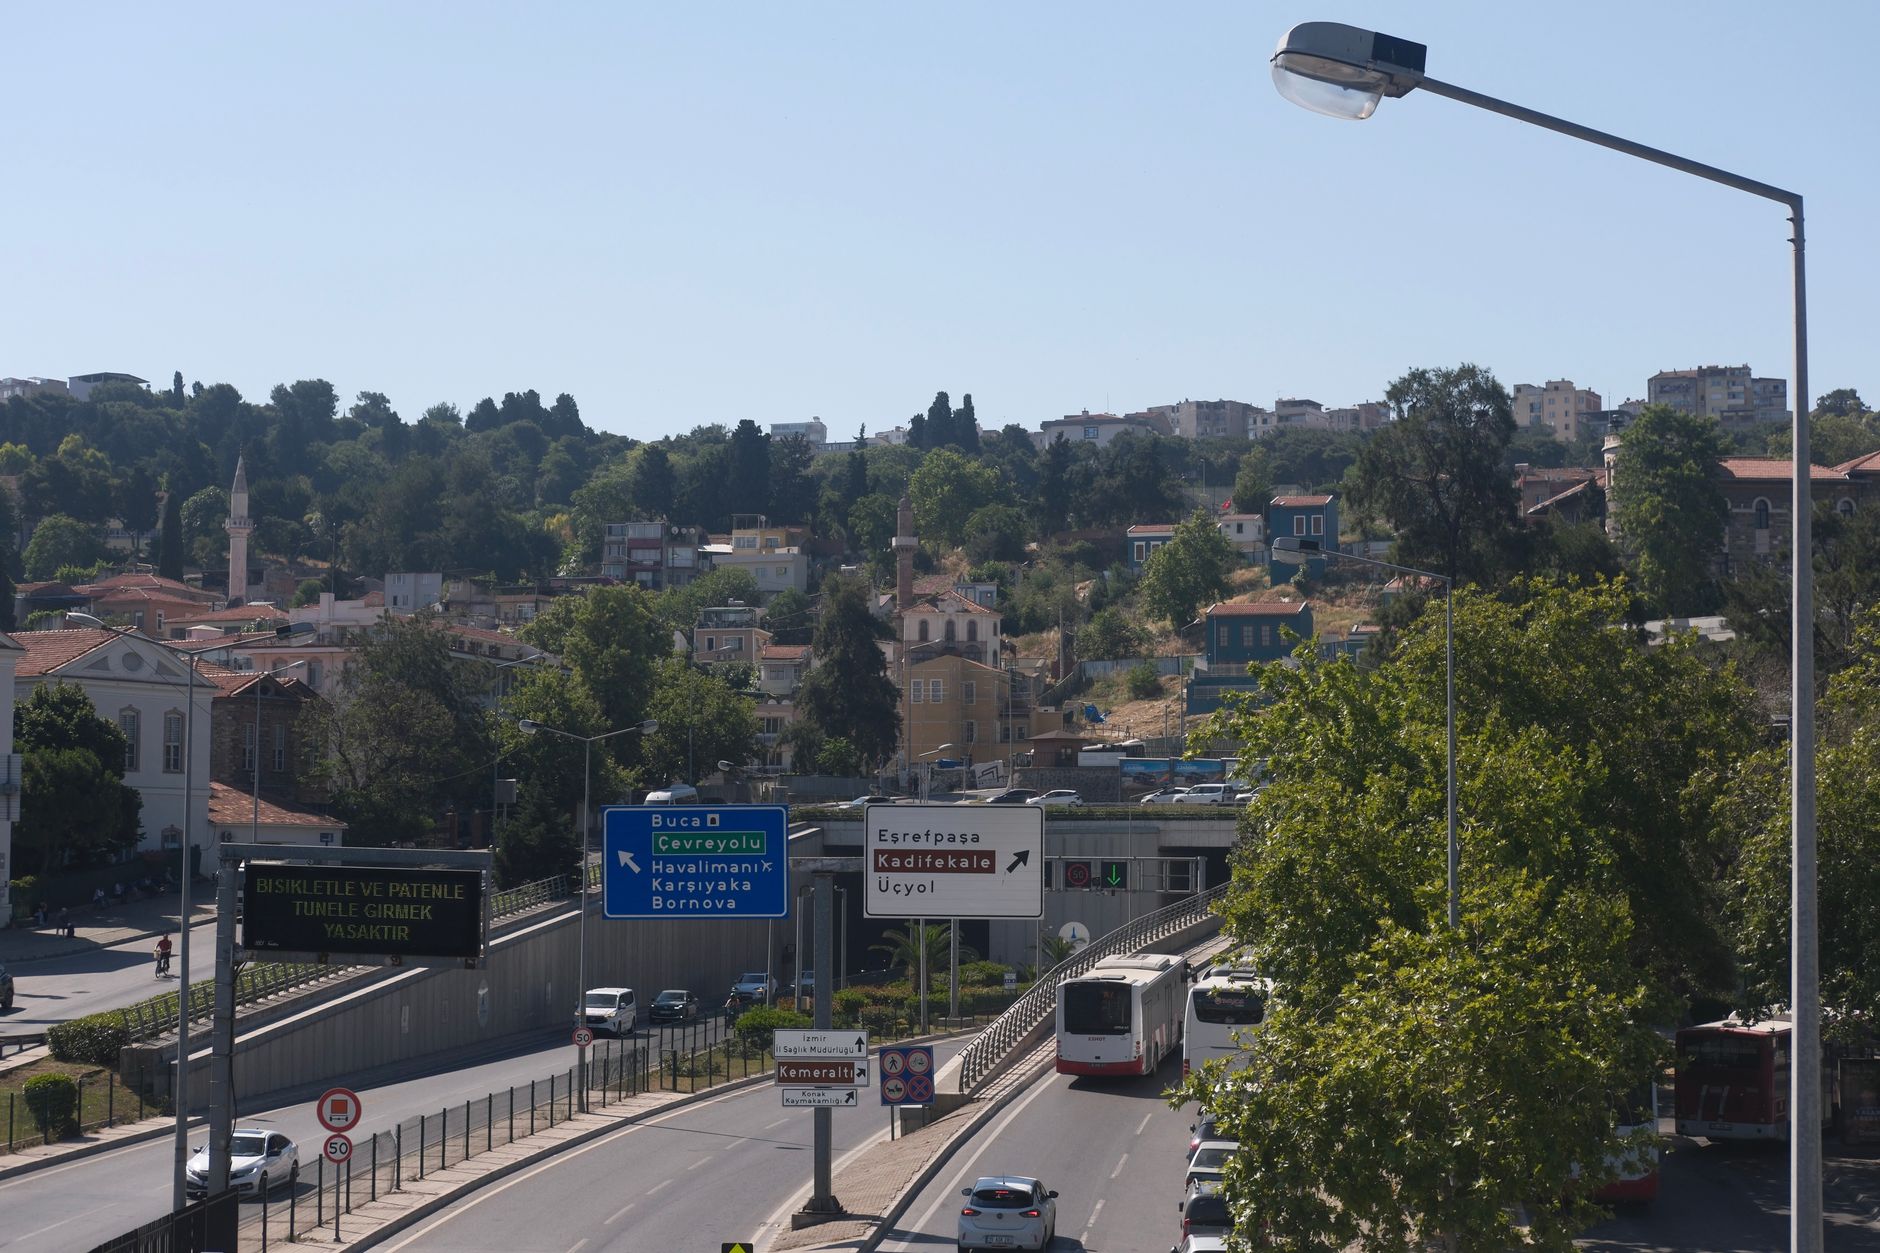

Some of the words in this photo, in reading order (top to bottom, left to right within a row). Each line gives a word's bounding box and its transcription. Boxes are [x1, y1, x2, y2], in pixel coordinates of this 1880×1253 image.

[652, 814, 700, 827] Buca
[658, 835, 761, 852] Çevreyolu
[878, 829, 981, 846] Eşrefpaşa
[652, 860, 758, 874] Havalimanı
[878, 854, 991, 869] Kadifekale
[360, 882, 385, 897] VE
[389, 882, 465, 900] PATENLE
[652, 878, 752, 894] Karşıyaka
[878, 876, 935, 896] Üçyol
[652, 896, 736, 909] Bornova
[323, 923, 409, 941] YASAKTIR
[576, 1033, 590, 1043] 50
[803, 1033, 827, 1042] İzmir
[783, 1045, 807, 1055] Sağlık
[810, 1045, 855, 1055] Müdürlüğü
[780, 1065, 854, 1078] Kemeraltı
[329, 1142, 348, 1155] 50
